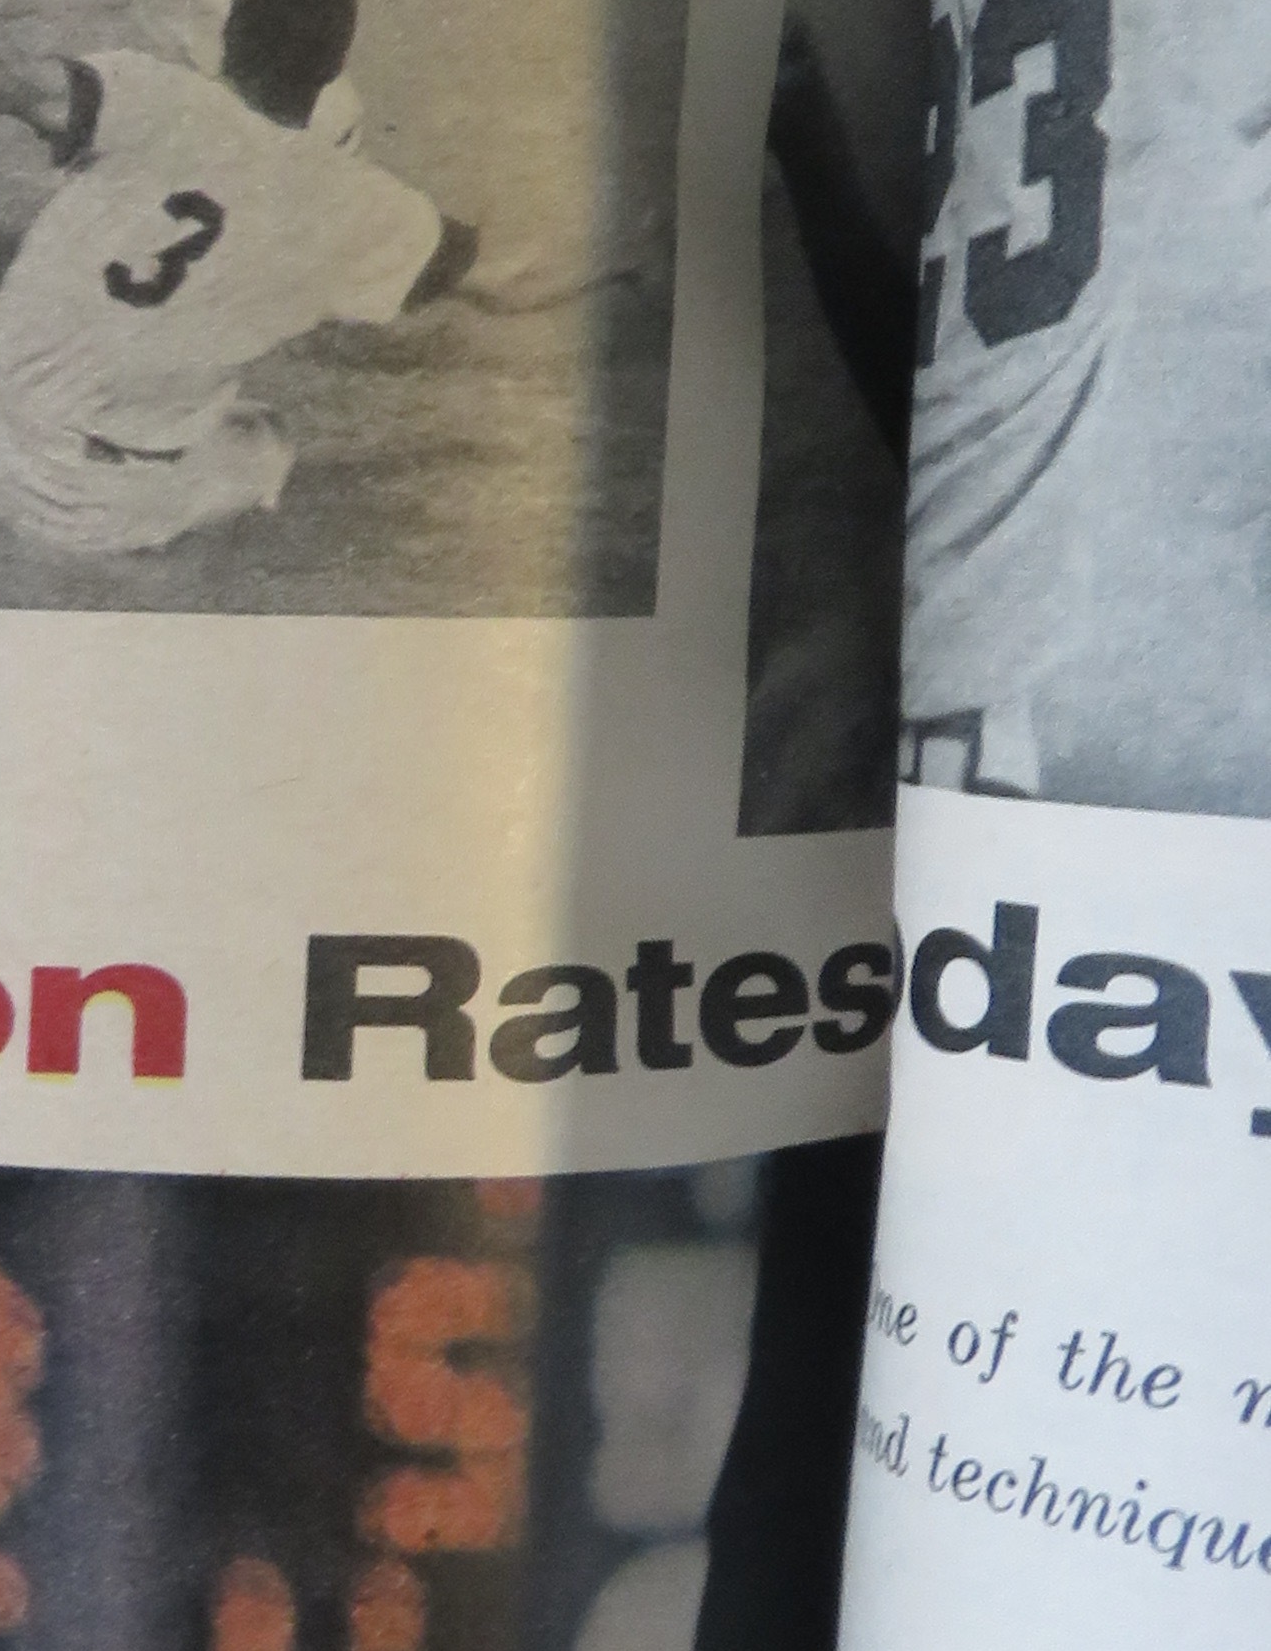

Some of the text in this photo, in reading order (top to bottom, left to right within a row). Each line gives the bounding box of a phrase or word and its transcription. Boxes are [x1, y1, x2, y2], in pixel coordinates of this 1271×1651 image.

[103, 188, 226, 309] 3
[301, 932, 895, 1084] Rates
[947, 1308, 1019, 1385] of
[1056, 1328, 1186, 1410] the
